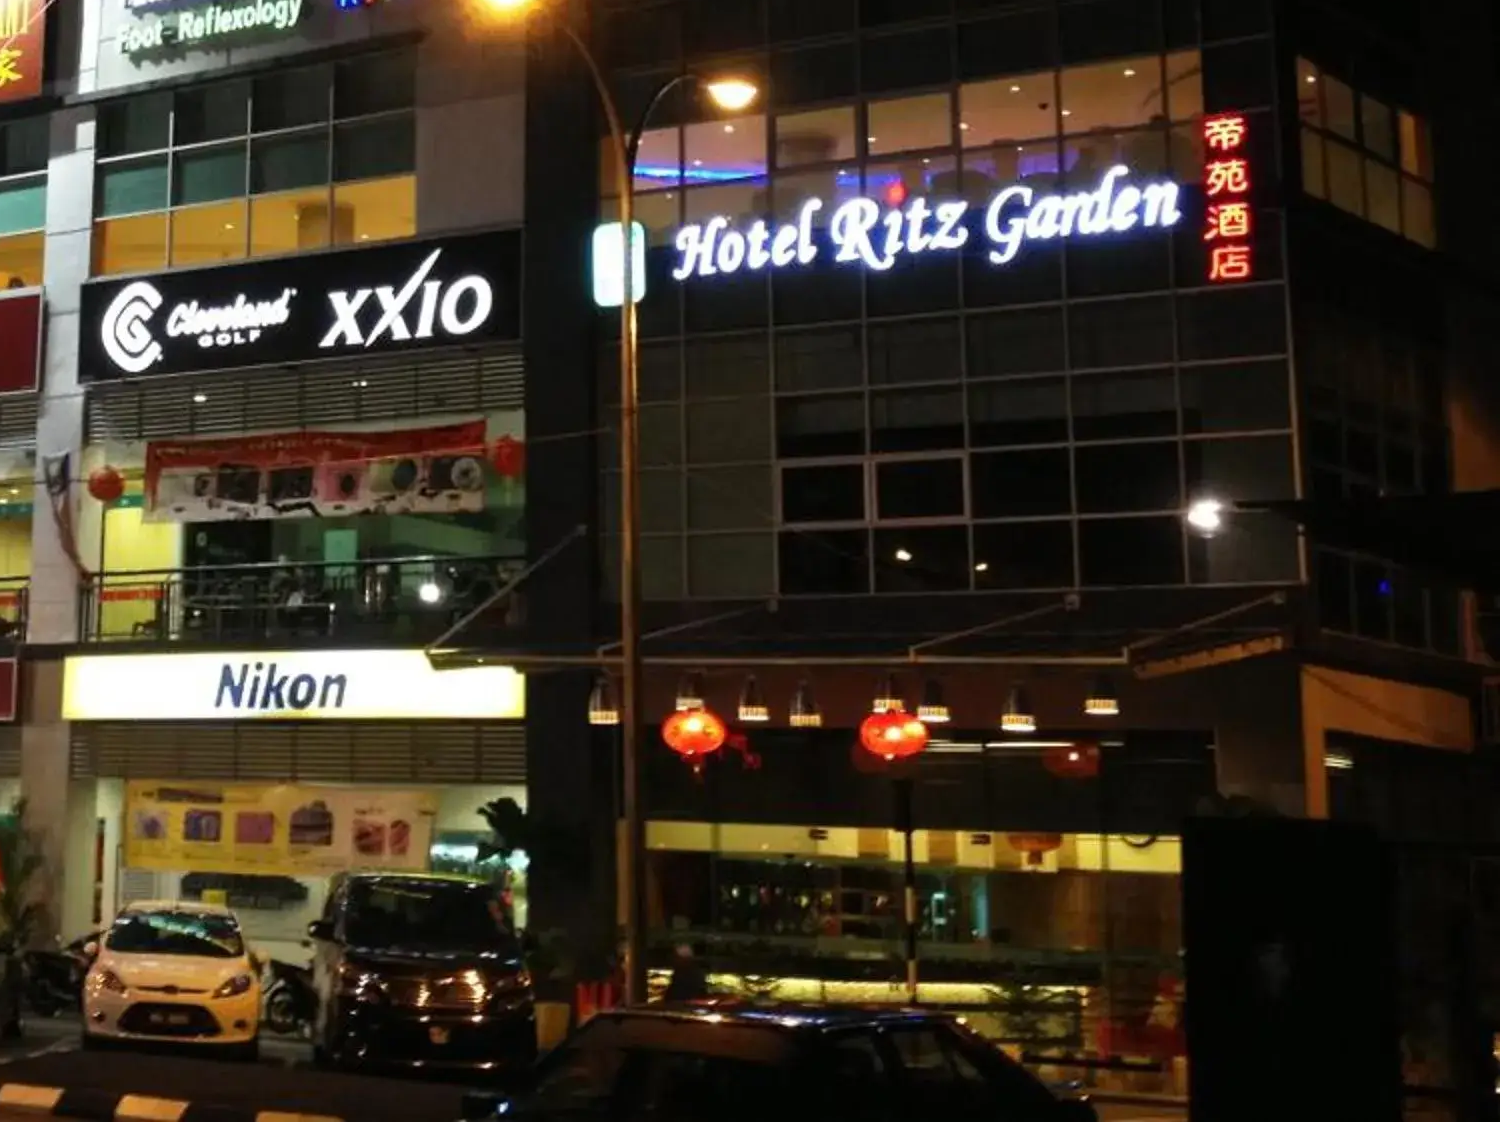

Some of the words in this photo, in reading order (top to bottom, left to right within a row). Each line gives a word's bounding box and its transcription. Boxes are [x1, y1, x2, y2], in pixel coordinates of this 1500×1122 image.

[115, 18, 164, 54] Foot
[672, 198, 822, 280] Hotel
[830, 181, 968, 271] Ritz
[985, 164, 1182, 264] Garden
[1203, 117, 1251, 281] 帝苑酒店
[318, 246, 493, 348] XXIO
[197, 328, 261, 348] GOLF
[214, 662, 347, 709] Nikon
